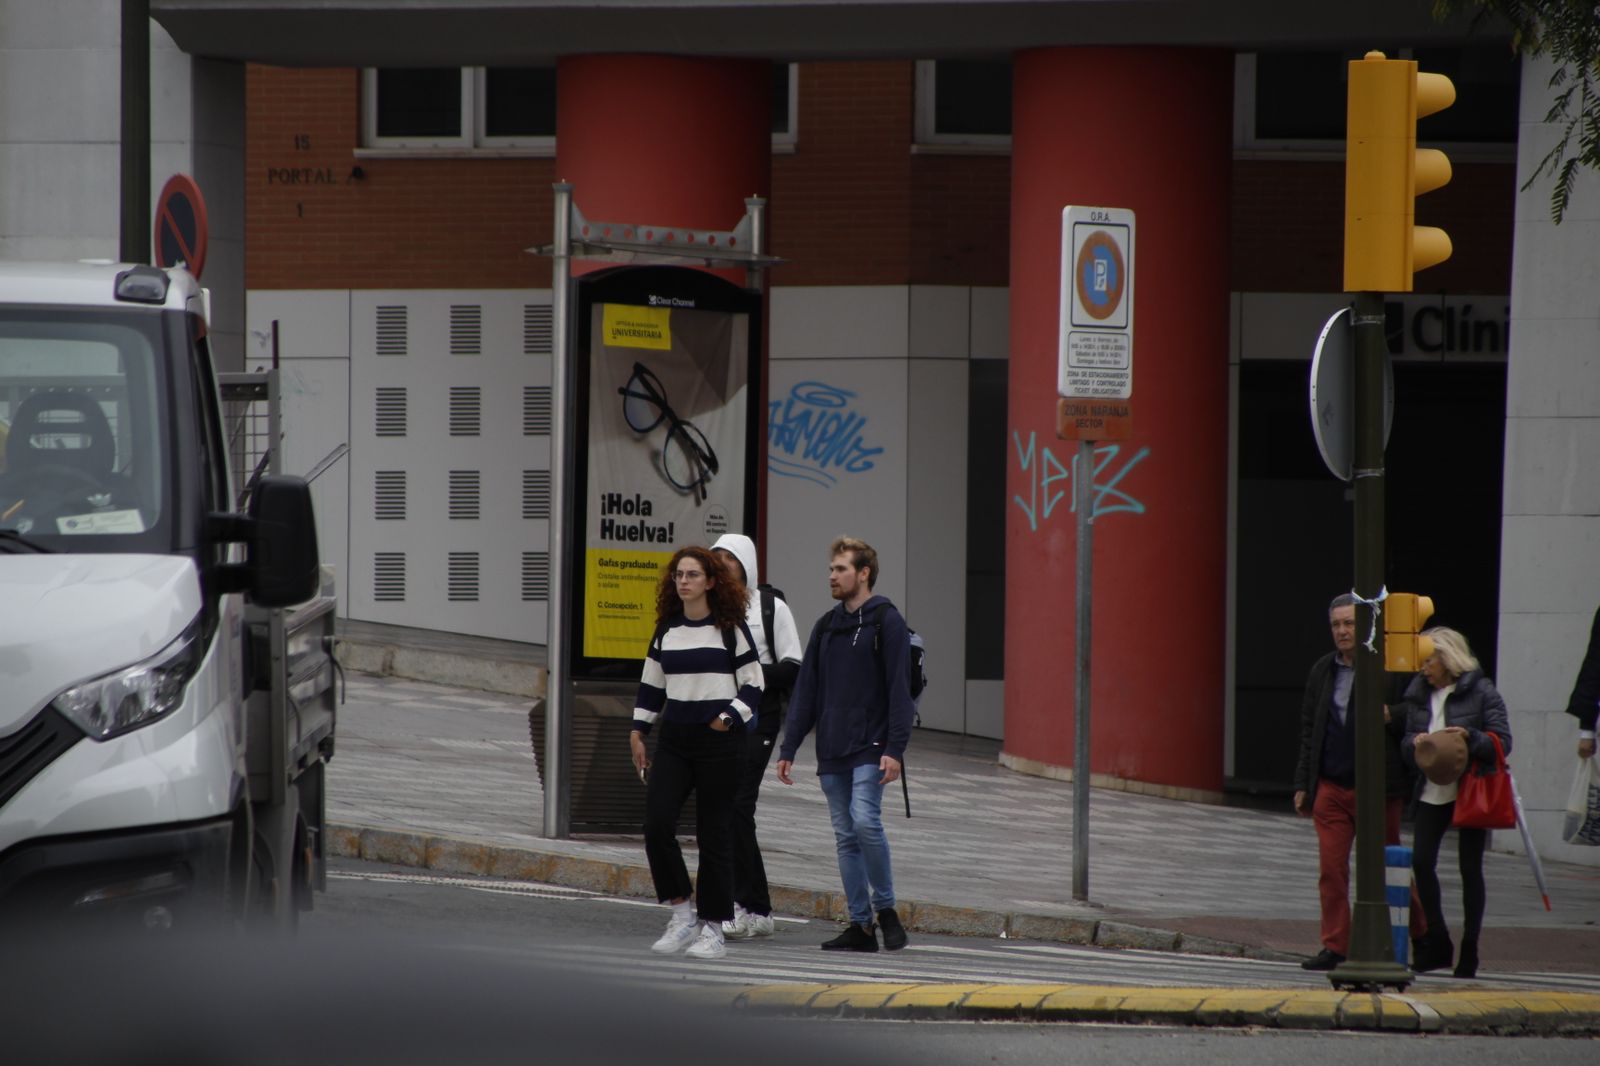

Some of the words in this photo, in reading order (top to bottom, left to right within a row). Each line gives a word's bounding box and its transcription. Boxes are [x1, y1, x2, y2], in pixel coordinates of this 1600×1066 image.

[294, 133, 311, 151] 15
[268, 167, 337, 185] PORTAL
[296, 201, 304, 219] 1
[611, 327, 663, 339] UNIVERSITARIA
[1064, 405, 1088, 417] ZONA
[1091, 406, 1129, 418] NARANJA
[1075, 418, 1104, 429] SECTOR
[601, 492, 652, 516] ¡Hola
[600, 518, 674, 544] Huelva!
[598, 558, 619, 569] Gafas
[620, 559, 658, 570] graduadas
